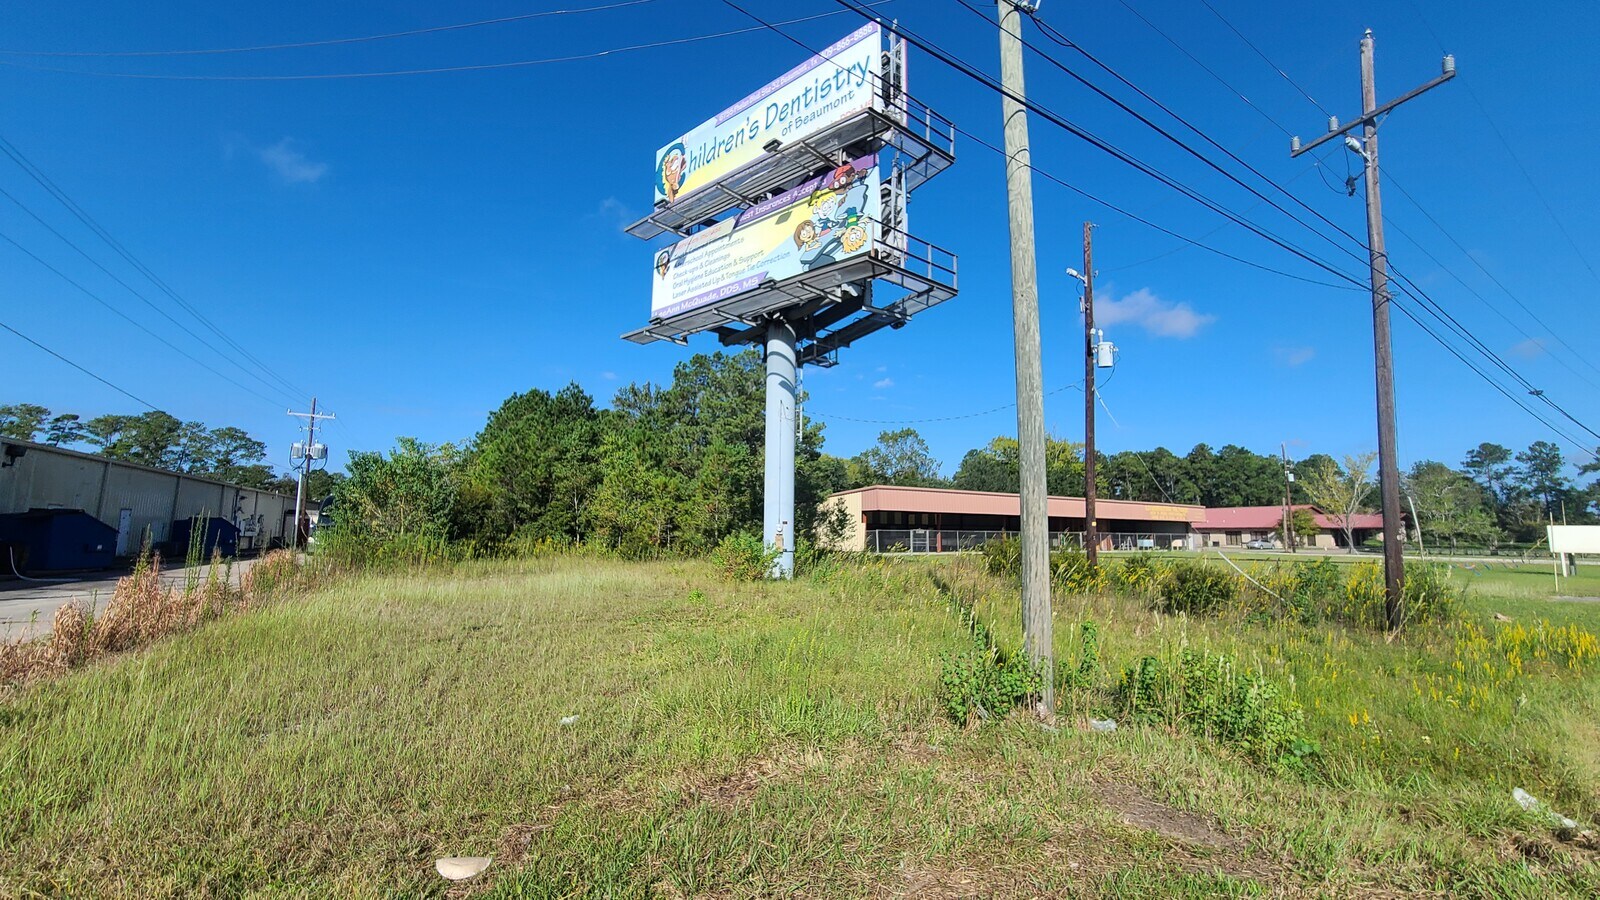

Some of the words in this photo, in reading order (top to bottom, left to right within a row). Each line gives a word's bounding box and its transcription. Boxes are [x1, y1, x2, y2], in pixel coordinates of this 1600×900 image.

[765, 55, 870, 130] Dentistry
[782, 121, 793, 137] of
[794, 90, 855, 131] Beaumont
[755, 195, 791, 215] Insurances
[793, 178, 827, 196] Aceptd
[704, 238, 744, 257] Appointments
[705, 259, 732, 278] Education
[739, 250, 765, 267] Support
[744, 276, 759, 288] MS
